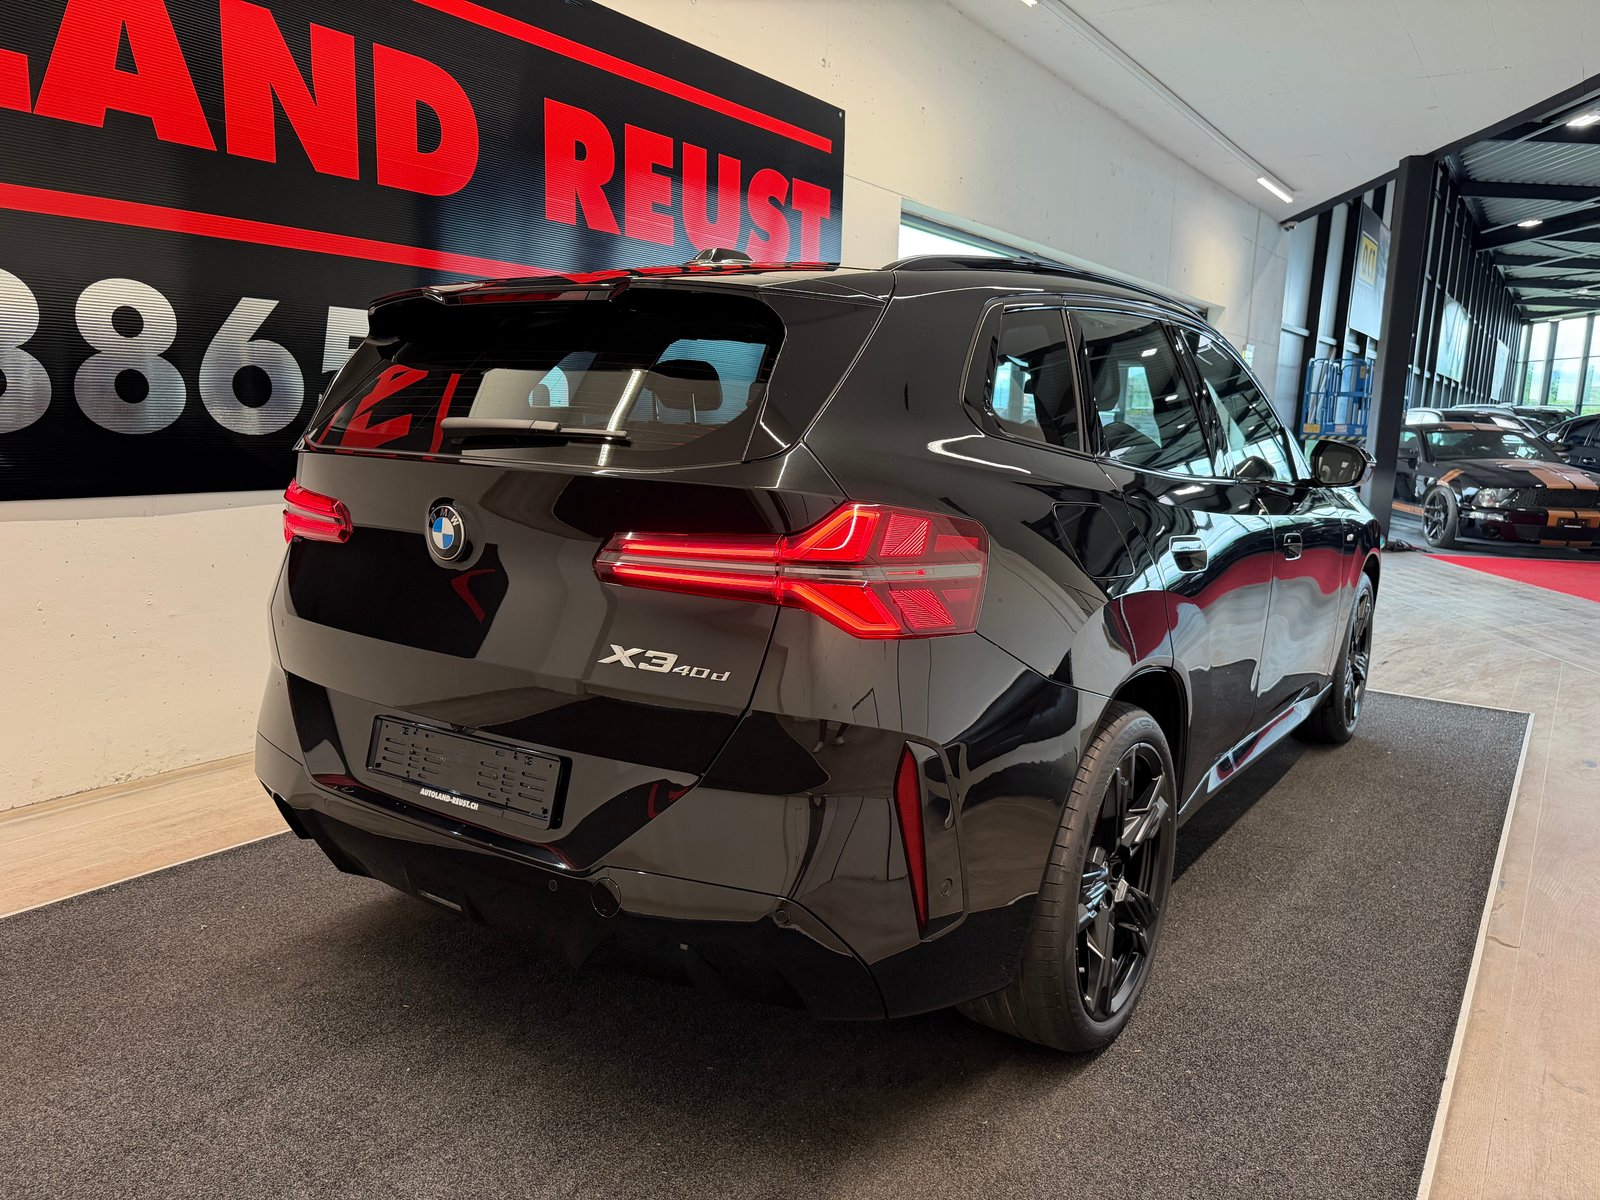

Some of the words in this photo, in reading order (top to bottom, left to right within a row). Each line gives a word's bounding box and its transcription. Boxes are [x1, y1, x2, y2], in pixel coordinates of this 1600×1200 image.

[544, 97, 831, 264] REUST
[430, 507, 460, 526] BMW
[420, 787, 479, 811] AUTOLAND-REUST.CH
